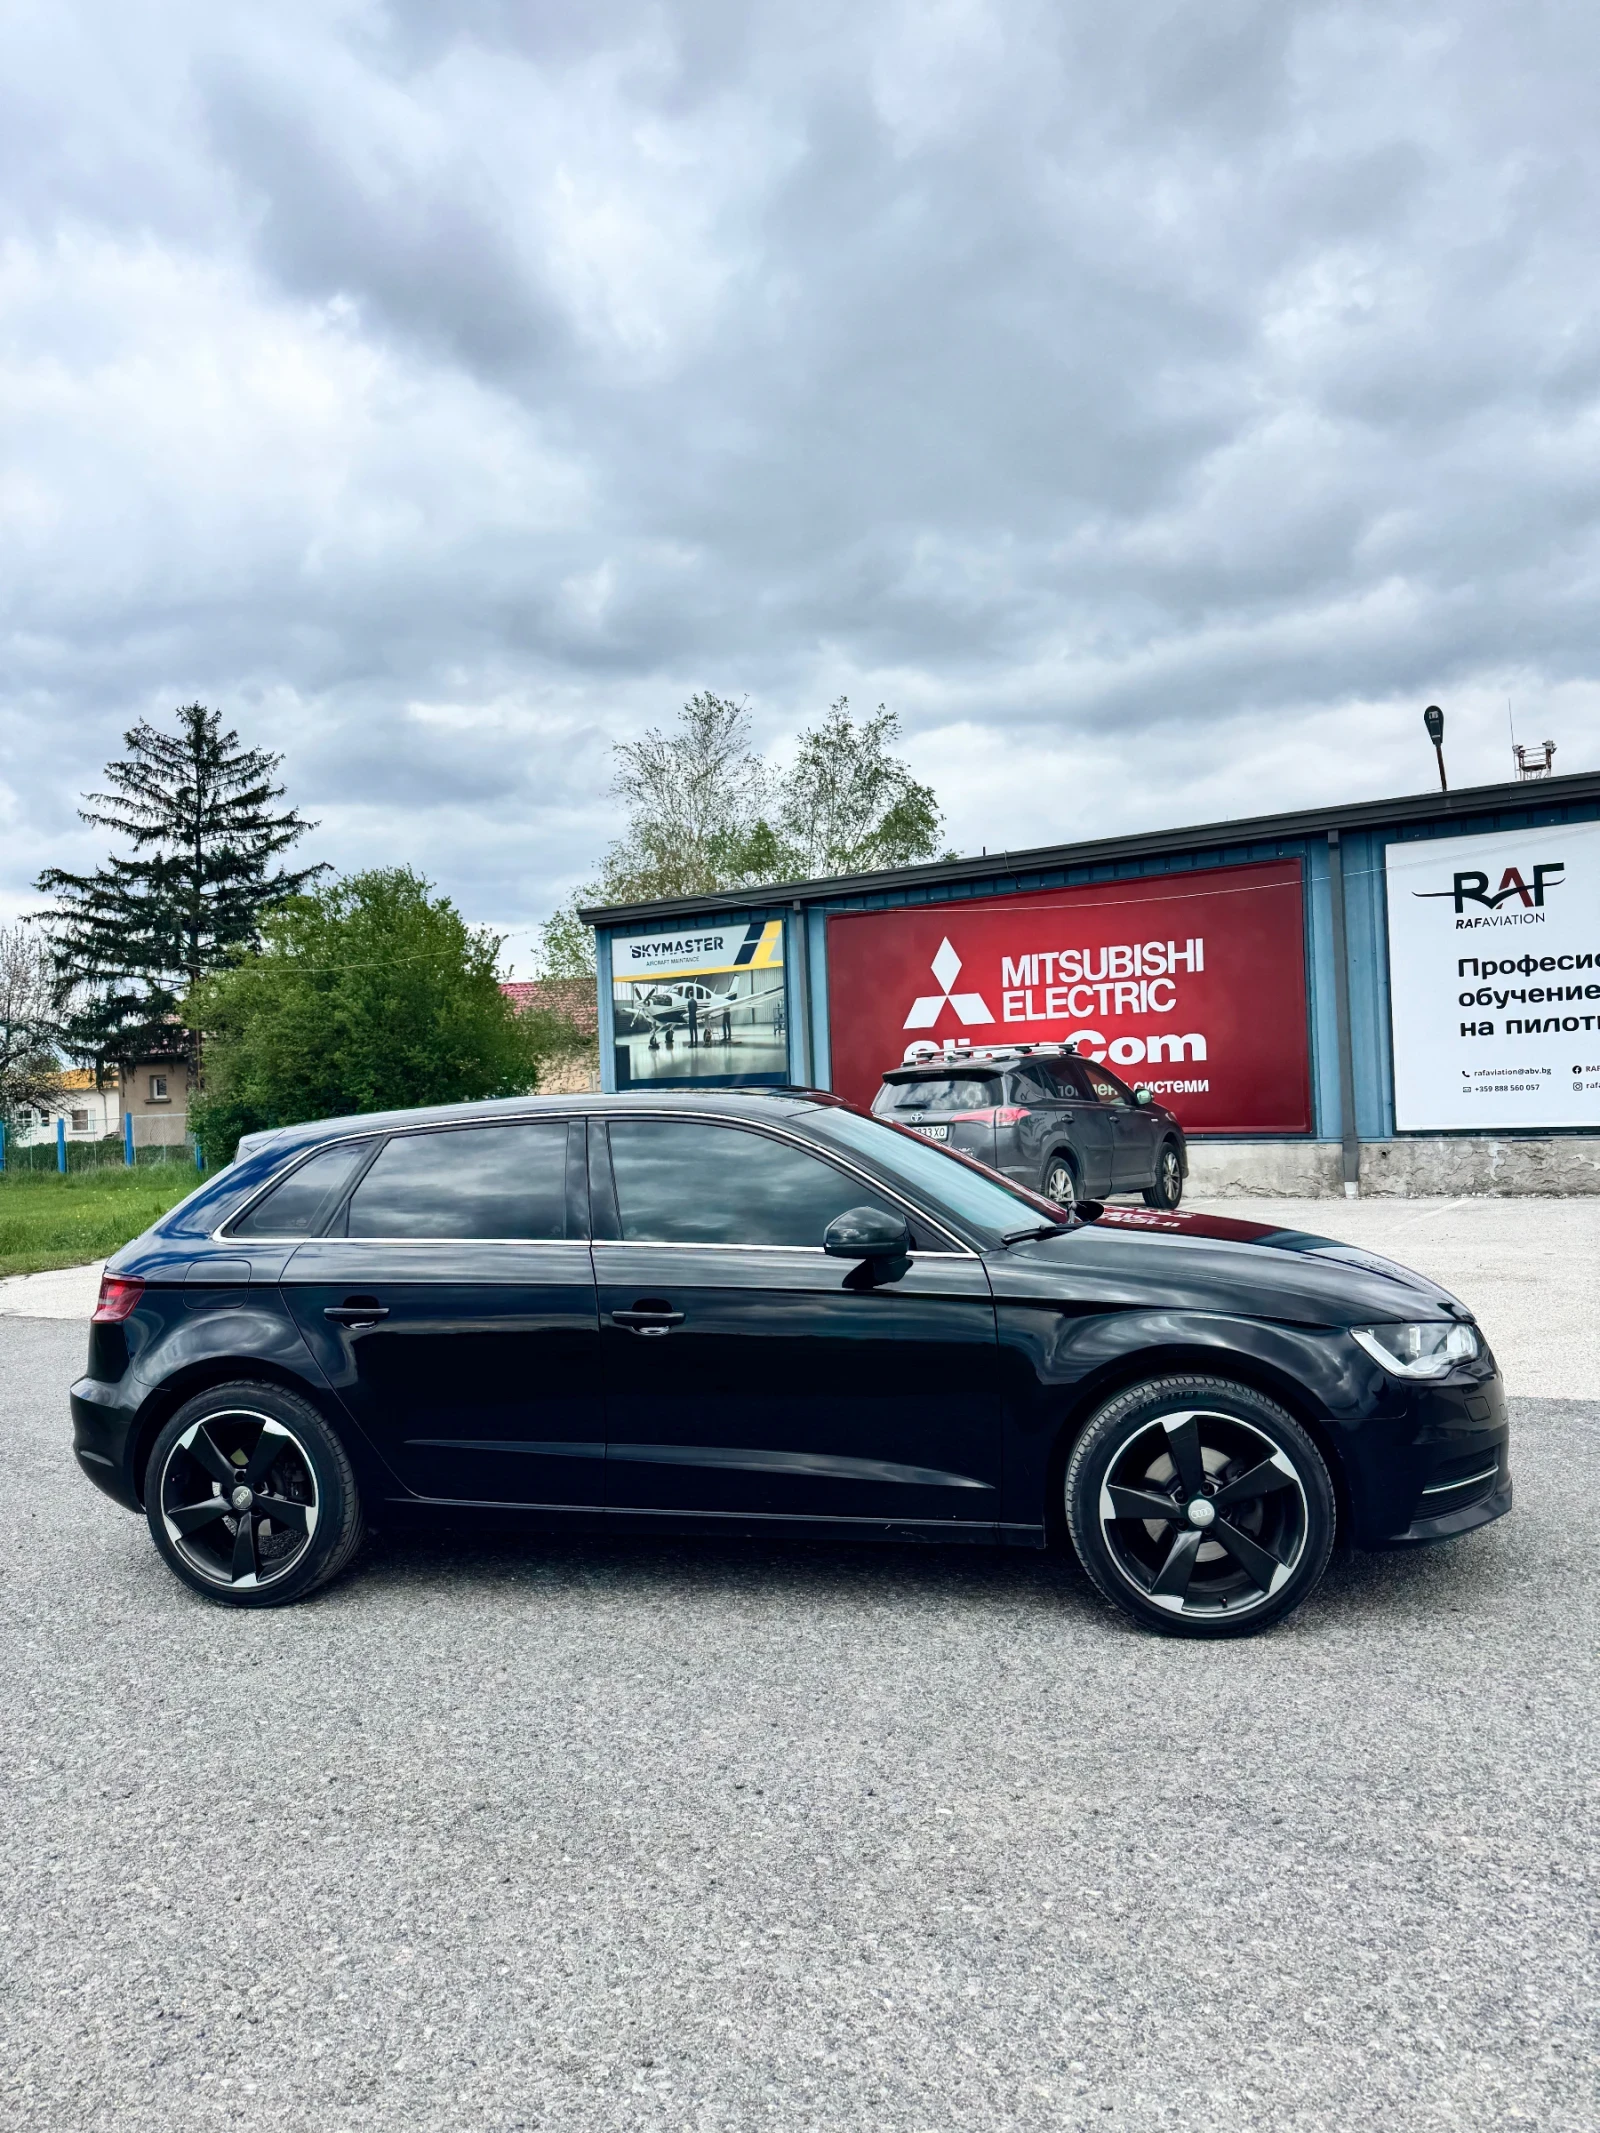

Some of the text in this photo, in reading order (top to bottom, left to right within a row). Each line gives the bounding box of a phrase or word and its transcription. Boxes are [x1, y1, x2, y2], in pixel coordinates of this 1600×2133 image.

[1453, 862, 1566, 914] RAF
[1455, 912, 1545, 930] RAFAVIATION
[630, 935, 724, 959] SKYMASTER
[1001, 937, 1204, 988] MITSUBISHI
[1002, 978, 1177, 1023] ELECTRIC
[1460, 1014, 1600, 1037] на пилот
[1474, 1067, 1552, 1077] rafaviation@abv.bg
[1475, 1085, 1493, 1093] +359
[1510, 1084, 1524, 1092] 560
[1525, 1083, 1540, 1091] 057
